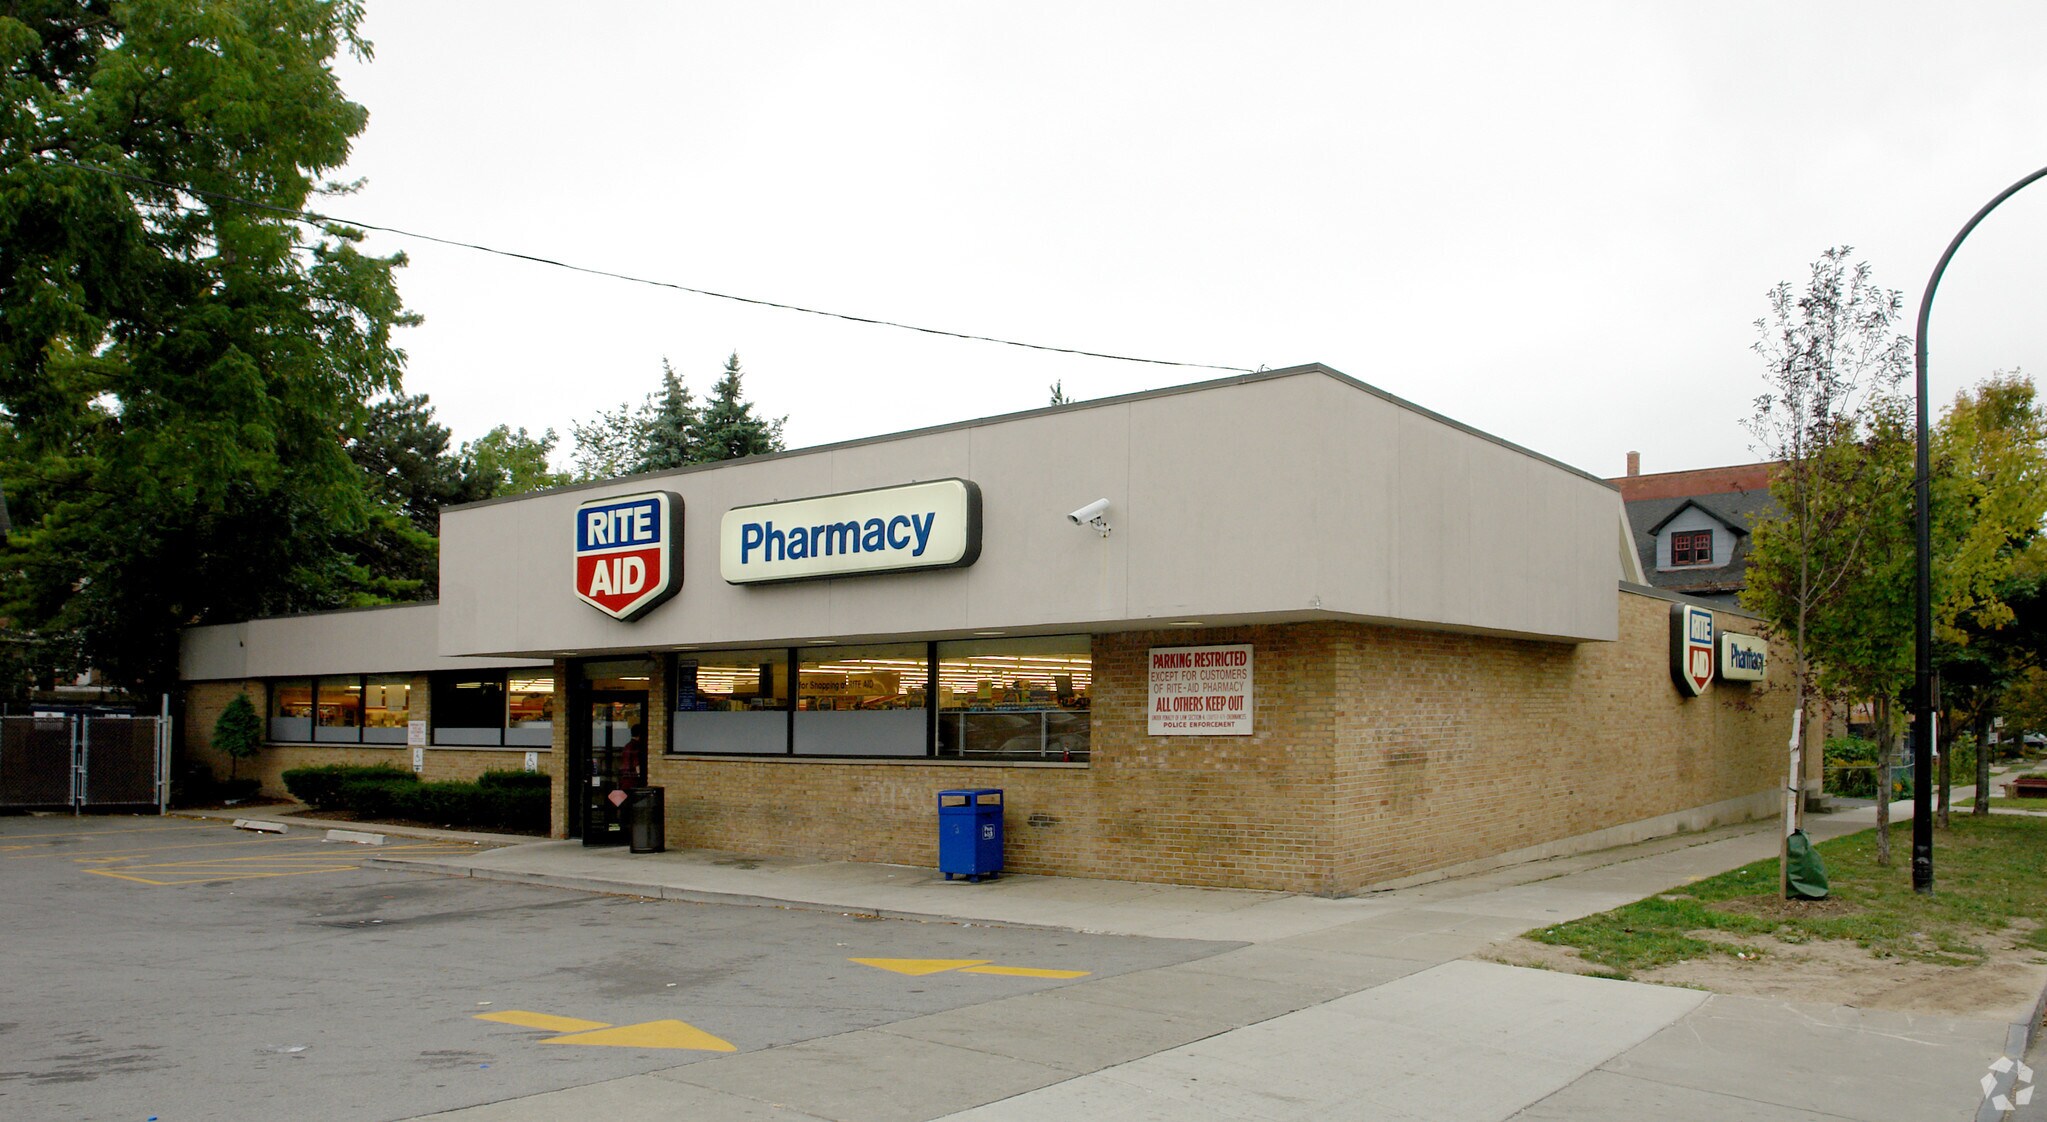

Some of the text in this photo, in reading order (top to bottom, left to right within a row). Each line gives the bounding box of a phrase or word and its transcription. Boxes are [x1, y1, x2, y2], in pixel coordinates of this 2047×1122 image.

[587, 505, 652, 546] RITE
[741, 512, 935, 565] Pharmacy
[588, 556, 646, 597] AID
[1691, 613, 1711, 641] RITE
[1153, 651, 1247, 669] PARKING RESTRICTED
[1692, 650, 1709, 678] AID
[1730, 643, 1765, 676] Pharmacy
[1151, 669, 1247, 682] EXCEPT FOR CUSTOMERS
[1153, 683, 1164, 694] OF
[1202, 681, 1244, 692] PHARMACY
[1156, 695, 1244, 712] ALL OTHERS KEEP OUT
